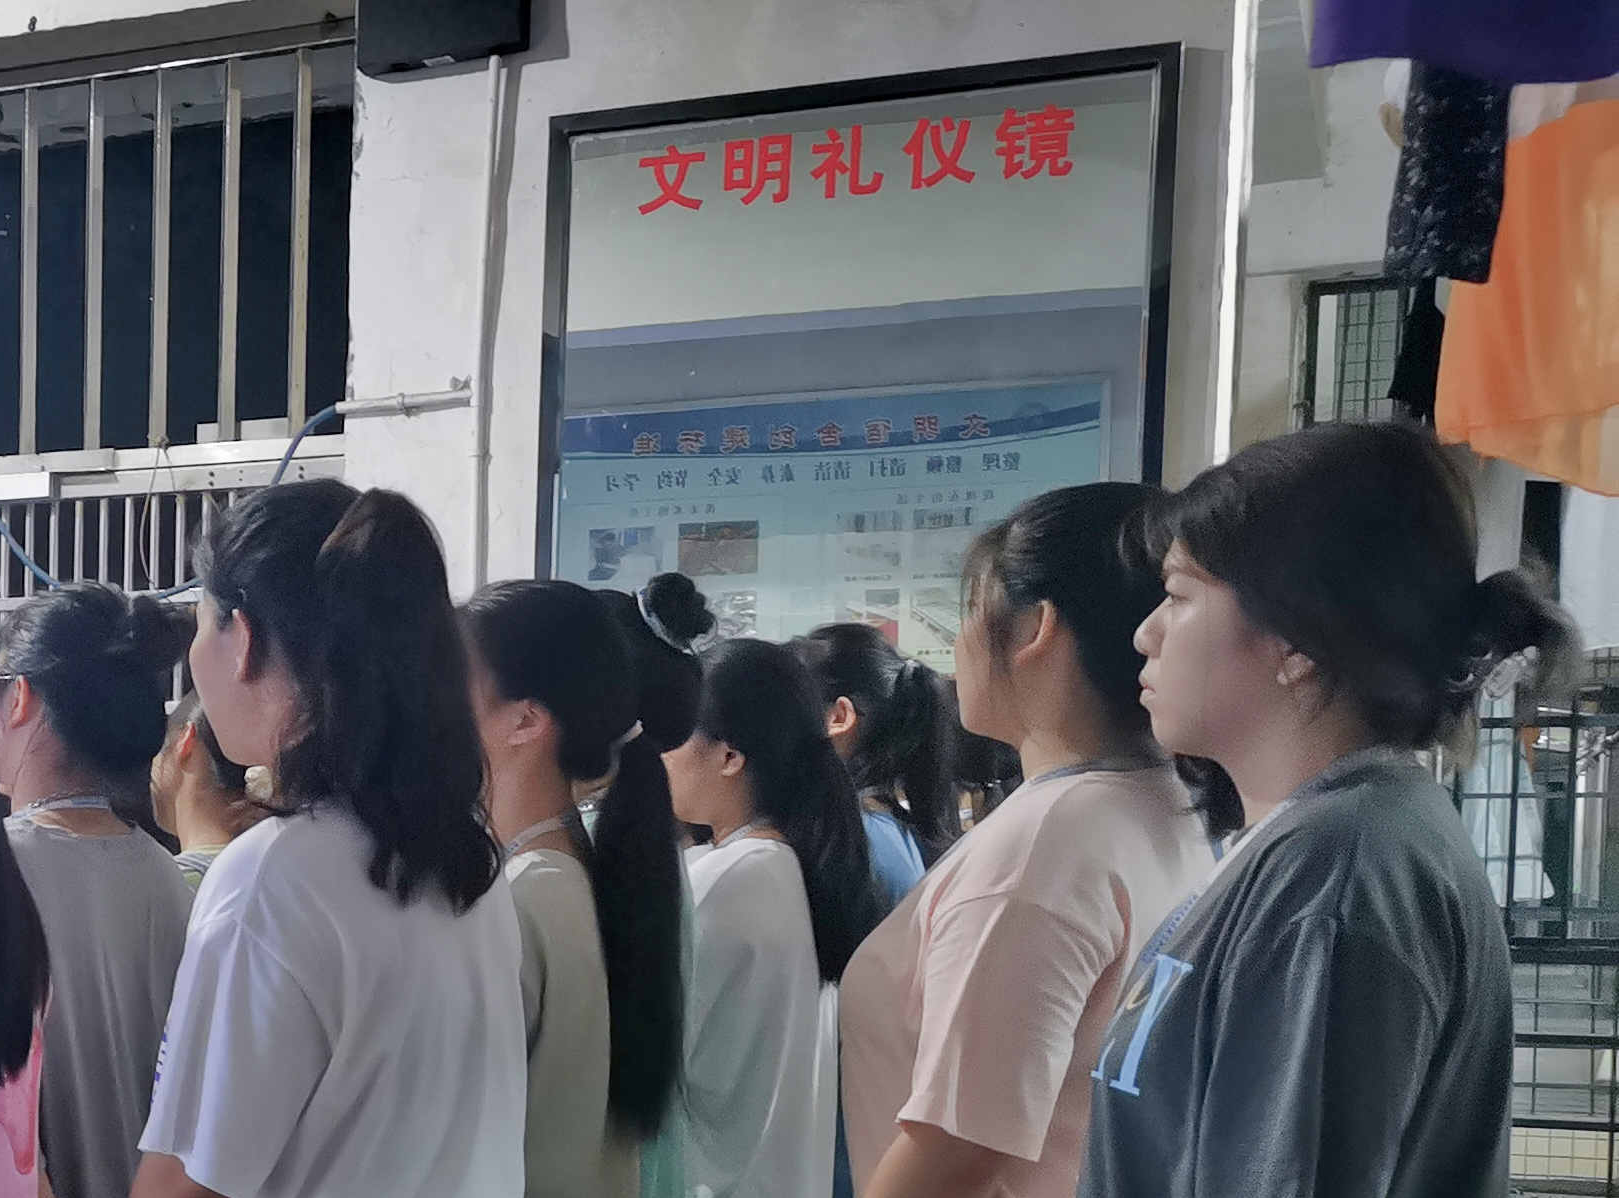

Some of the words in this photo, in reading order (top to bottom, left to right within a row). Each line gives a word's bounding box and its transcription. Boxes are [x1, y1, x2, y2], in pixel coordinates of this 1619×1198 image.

[638, 104, 1076, 216] 文明礼仪镜
